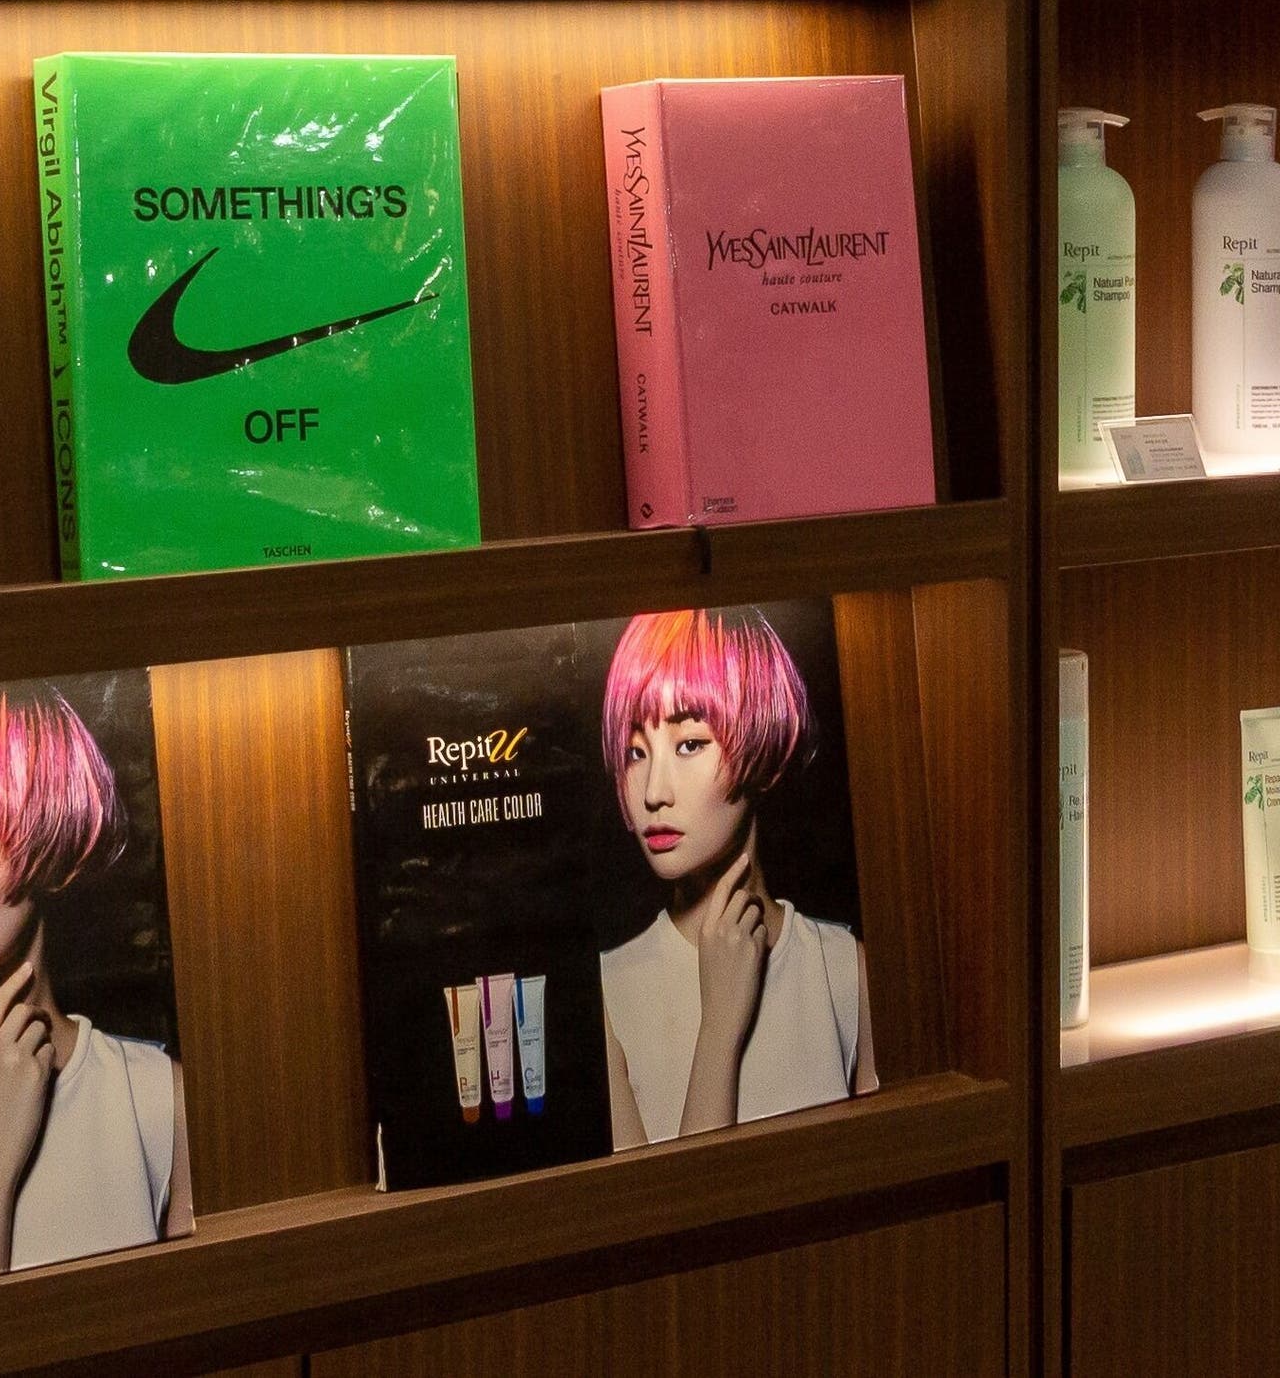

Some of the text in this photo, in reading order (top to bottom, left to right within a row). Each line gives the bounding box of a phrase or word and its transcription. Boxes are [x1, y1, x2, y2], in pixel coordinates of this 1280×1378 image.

[133, 184, 408, 222] SOMETHING'S
[1063, 241, 1101, 262] Repit
[1222, 235, 1258, 255] Repit
[761, 272, 843, 286] haute couture
[1093, 277, 1124, 289] Natural
[1093, 290, 1131, 302] Shampoo
[38, 70, 63, 178] Virgil
[51, 397, 77, 543] ICONS
[770, 300, 837, 315] CATWALK
[636, 373, 650, 455] CATWALK
[244, 407, 320, 444] OFF
[262, 544, 312, 558] TASCHEN
[1248, 749, 1269, 765] Repit
[430, 768, 520, 785] UNIVERSAL
[423, 792, 542, 829] HEALTH CARE COLOR
